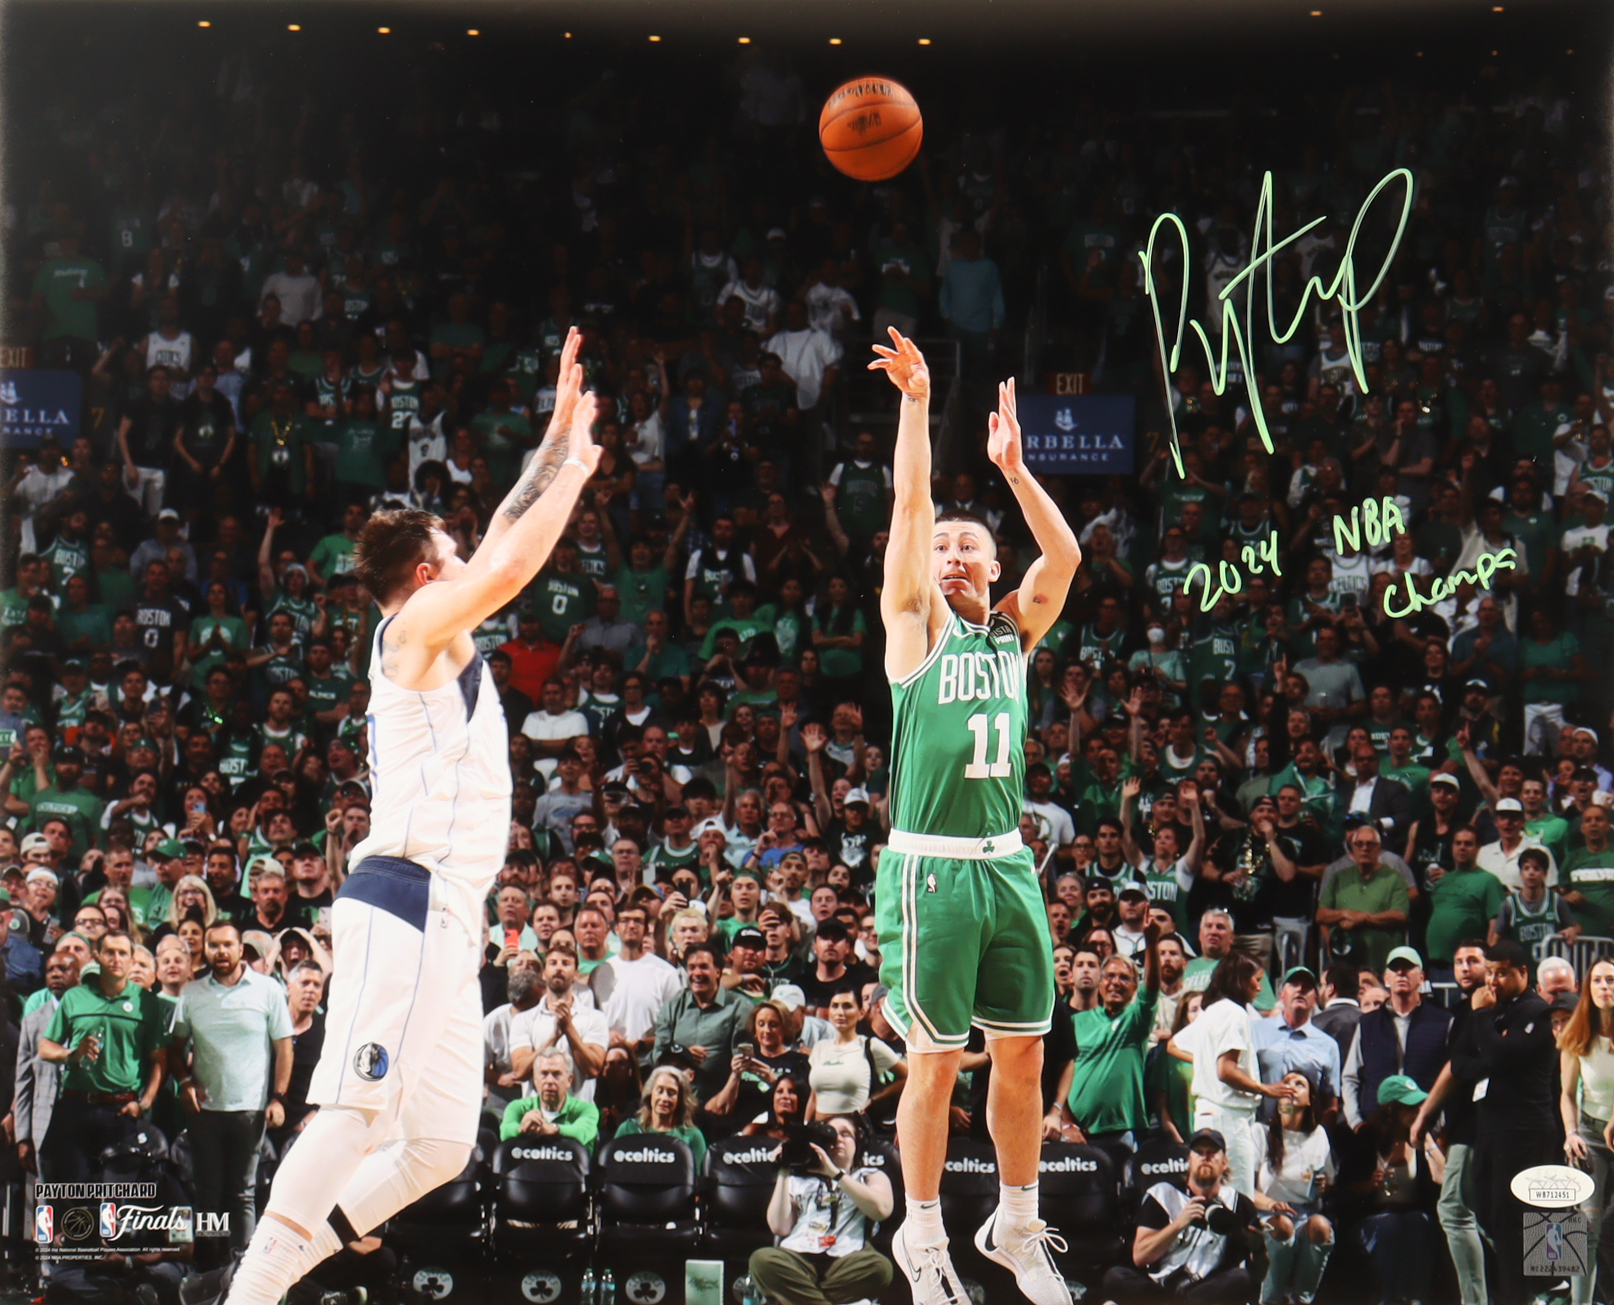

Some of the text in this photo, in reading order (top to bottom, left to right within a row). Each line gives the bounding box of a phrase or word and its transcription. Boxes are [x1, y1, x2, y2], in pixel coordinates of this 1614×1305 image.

[1055, 372, 1084, 395] EXIT
[5, 407, 71, 425] ELLA
[1026, 434, 1125, 450] RBELLA
[1025, 453, 1109, 462] NSURANCE
[1333, 496, 1406, 556] NBA
[1183, 530, 1282, 613] 2024
[552, 593, 569, 616] 0
[136, 608, 172, 627] BOSTON
[144, 628, 160, 649] 0
[995, 633, 1015, 645] PRINT
[938, 651, 1021, 705] BOSTON
[1224, 659, 1237, 680] 7
[964, 712, 1012, 779] 11
[1146, 881, 1179, 901] STON
[511, 1146, 573, 1162] @celtics
[613, 1147, 675, 1164] @celtics
[723, 1147, 777, 1165] @celtic
[862, 1152, 885, 1165] ics
[945, 1156, 996, 1174] celtics
[1141, 1157, 1190, 1175] @celtic
